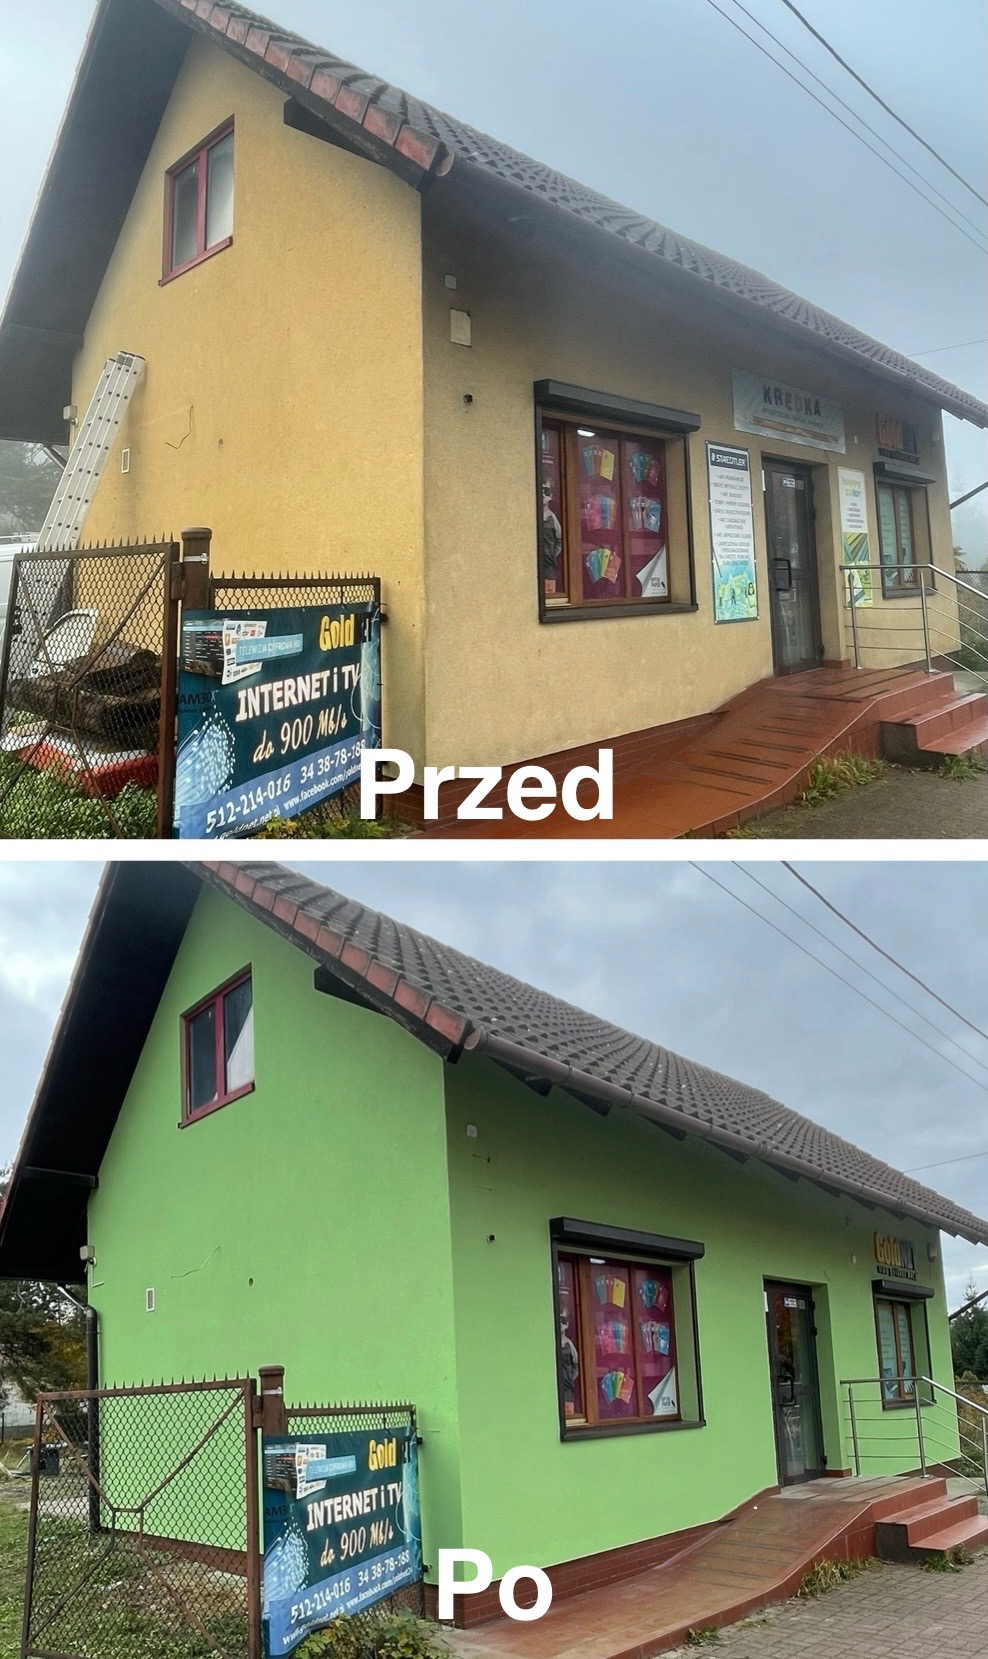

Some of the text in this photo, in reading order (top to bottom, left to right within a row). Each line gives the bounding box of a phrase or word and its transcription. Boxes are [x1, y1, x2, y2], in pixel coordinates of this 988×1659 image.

[716, 454, 746, 467] STAEDTLER
[236, 663, 361, 722] INTERNET i TV
[253, 729, 275, 763] do
[281, 714, 313, 754] 900
[206, 739, 366, 834] 512-214-016 34 38-78-188
[307, 1482, 402, 1531] INTERNET i TV
[320, 1538, 335, 1567] do
[340, 1527, 366, 1561] 900
[290, 1550, 410, 1624] 512-214-016 34 38-78-188
